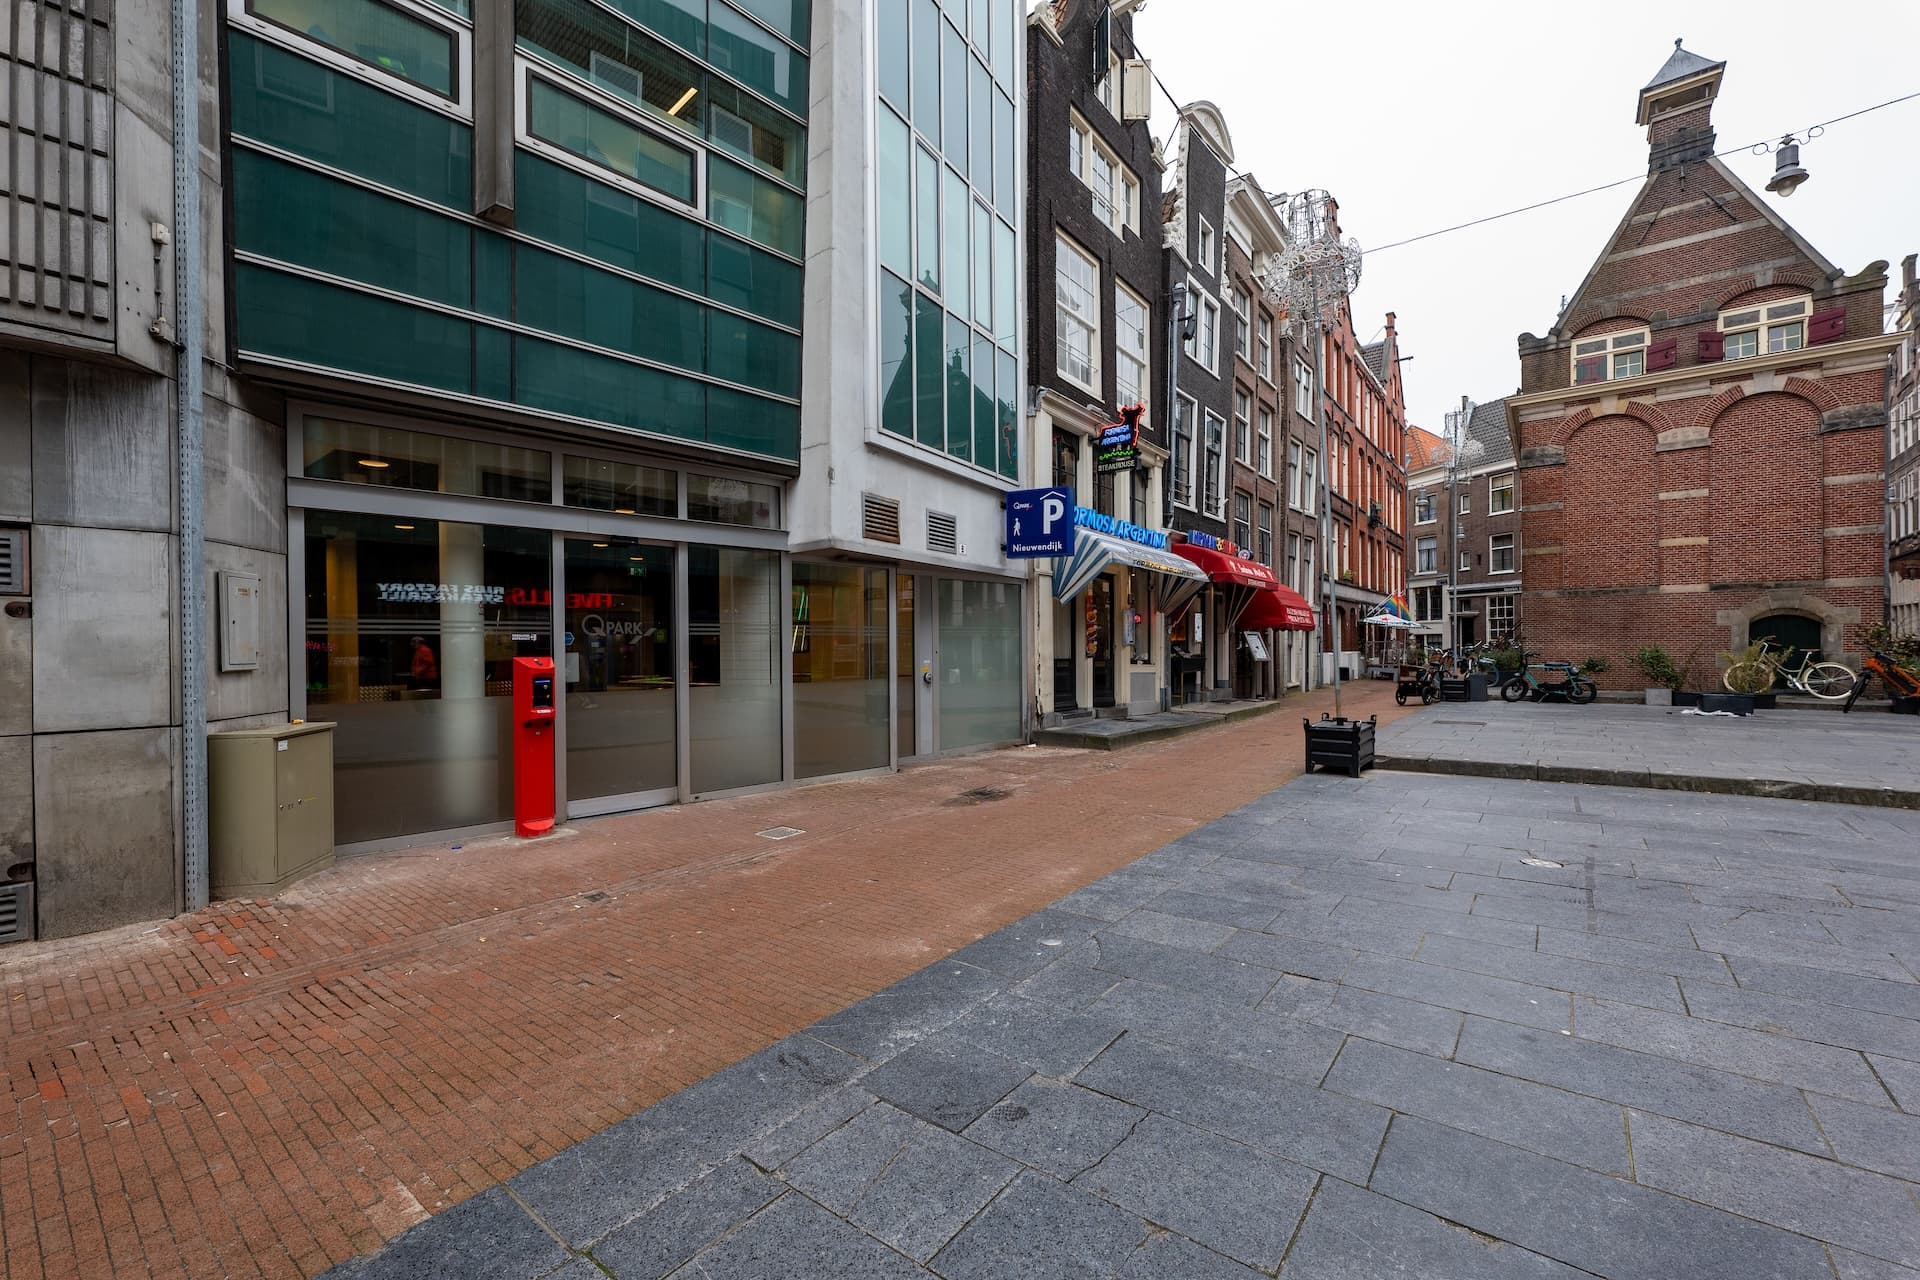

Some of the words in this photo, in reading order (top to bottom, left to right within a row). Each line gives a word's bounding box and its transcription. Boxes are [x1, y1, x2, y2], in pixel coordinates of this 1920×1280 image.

[1098, 460, 1135, 471] STEAKHOUSE
[1043, 499, 1064, 534] P
[1074, 506, 1115, 534] ORMOSA
[1119, 522, 1165, 549] ARGENTINA
[1012, 541, 1062, 552] Nieuwendijk
